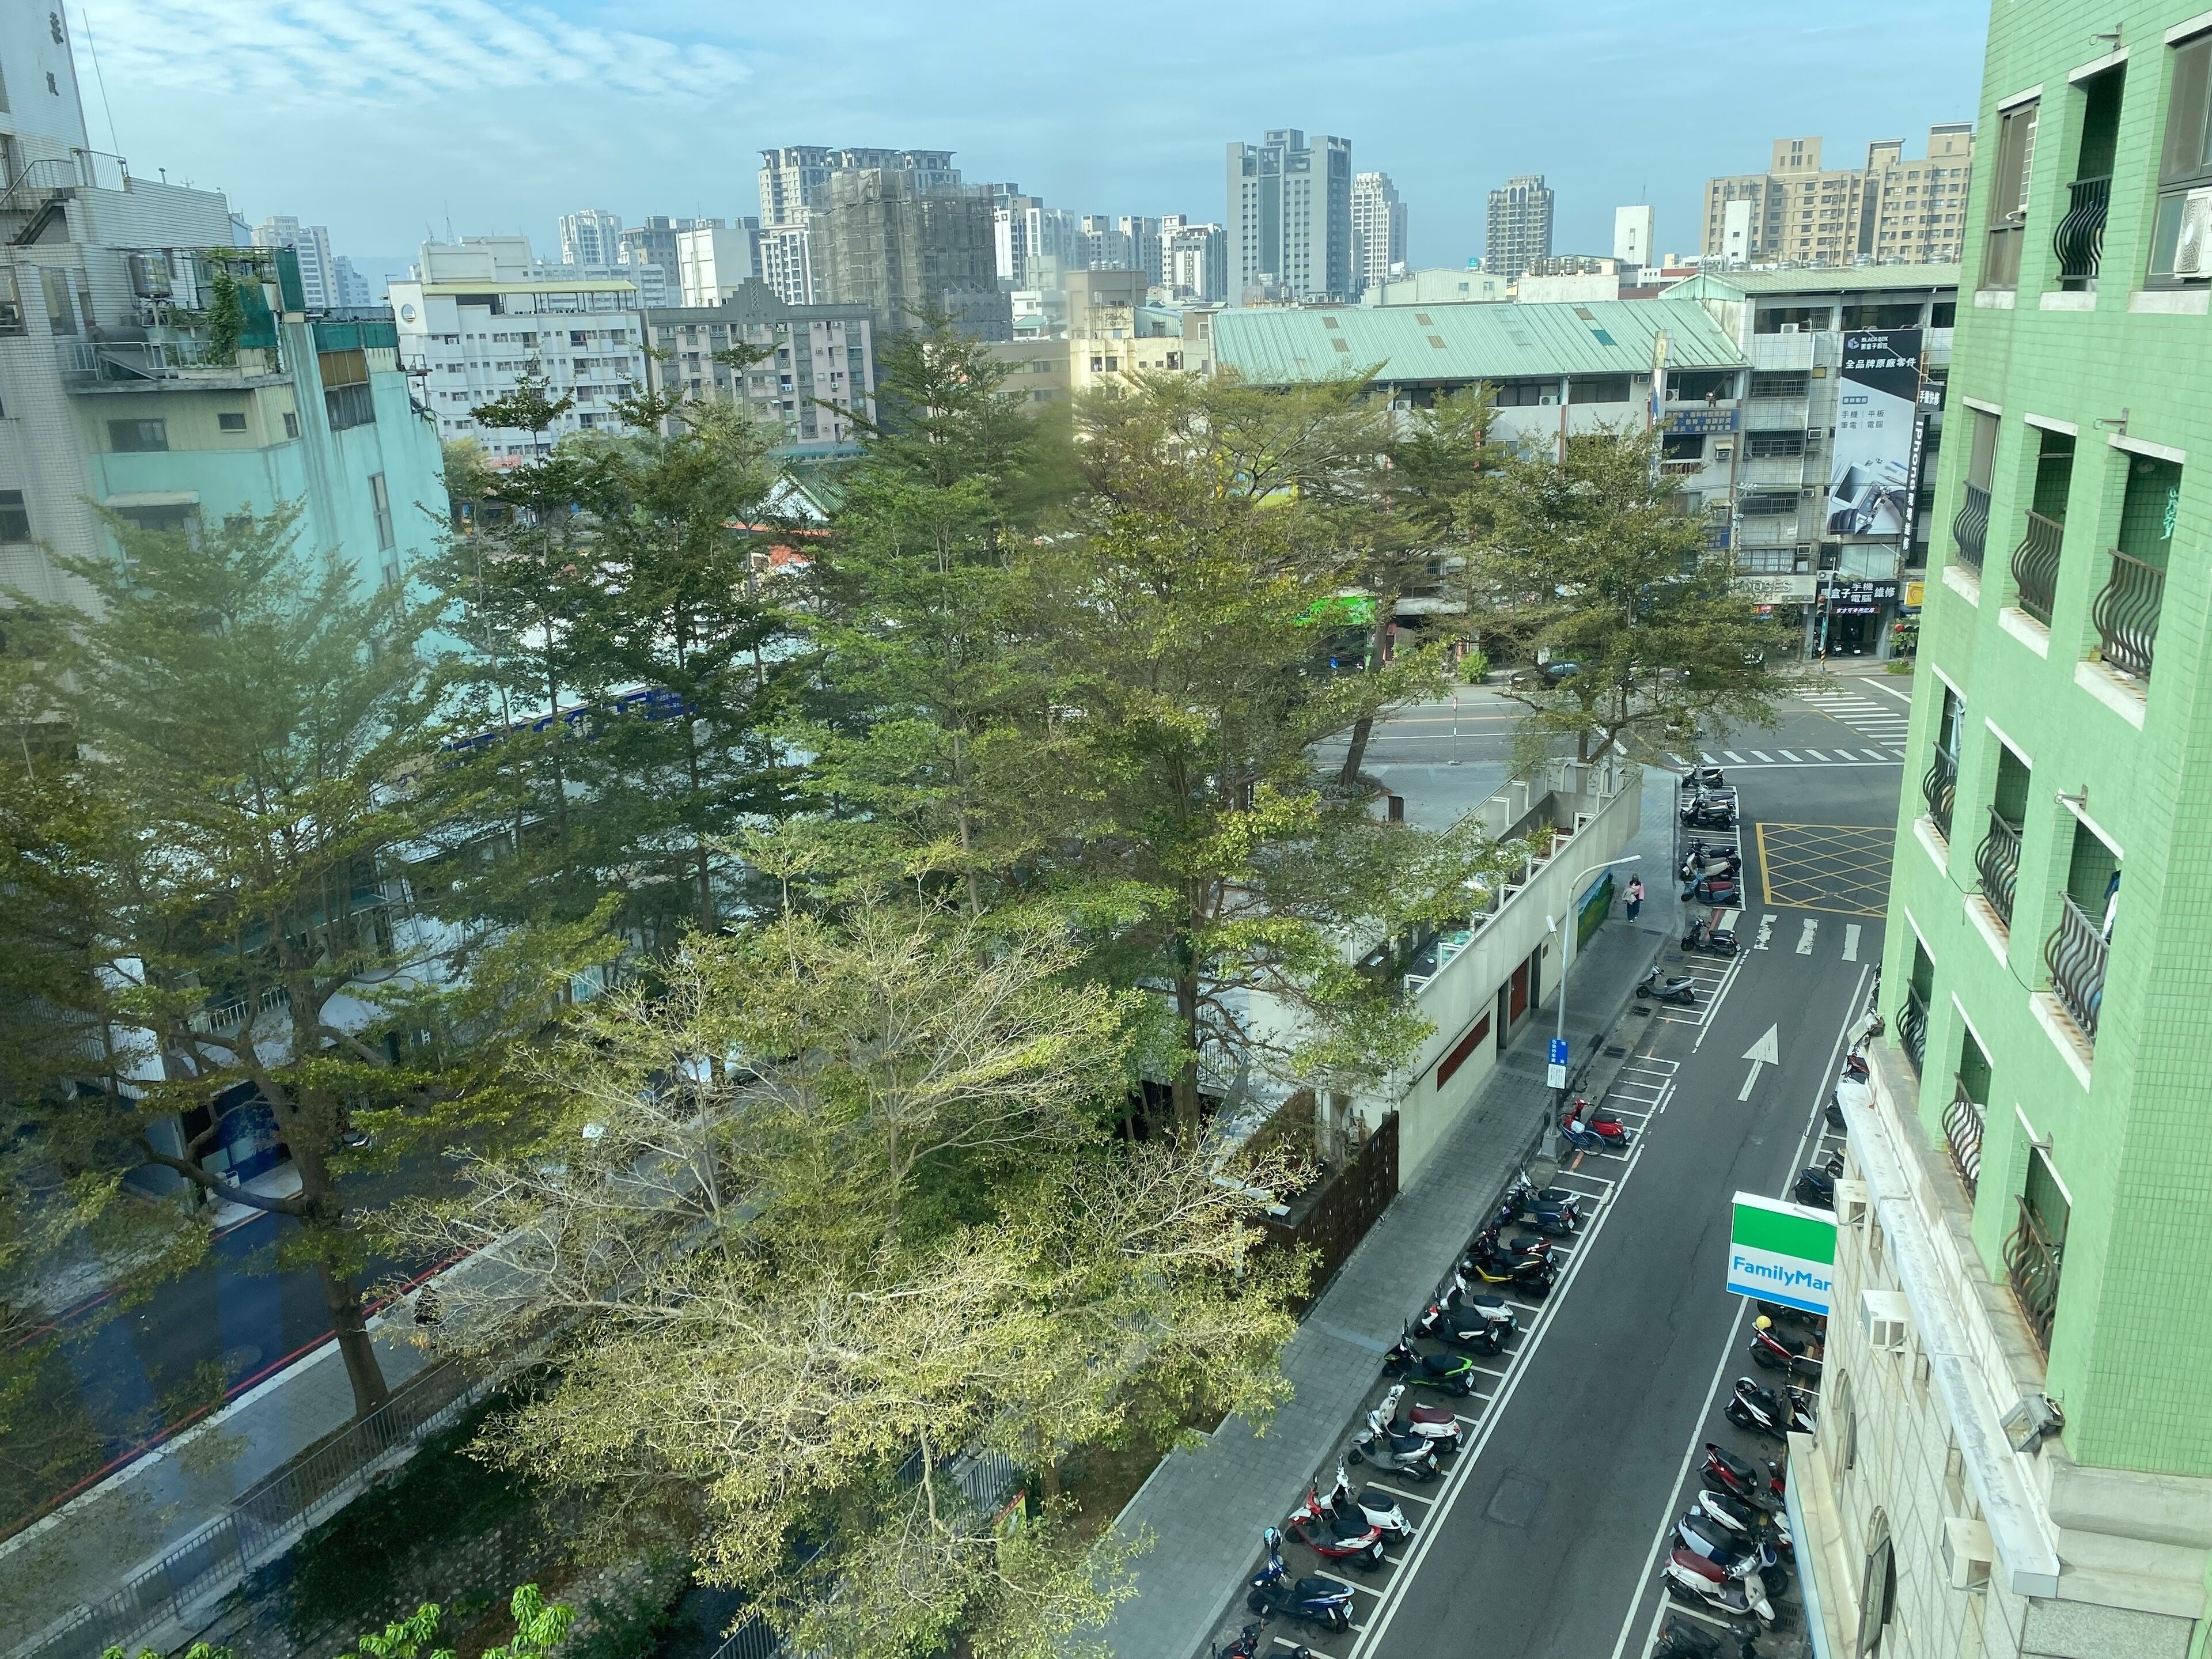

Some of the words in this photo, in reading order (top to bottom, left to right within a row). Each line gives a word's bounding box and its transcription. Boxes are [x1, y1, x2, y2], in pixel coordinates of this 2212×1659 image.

[1845, 357, 1916, 369] 全品牌原廠零件
[1851, 582, 1873, 591] 手機
[1874, 587, 1896, 598] 維修
[1851, 594, 1872, 603] 電腦
[1733, 1256, 1831, 1291] FamilyMar
